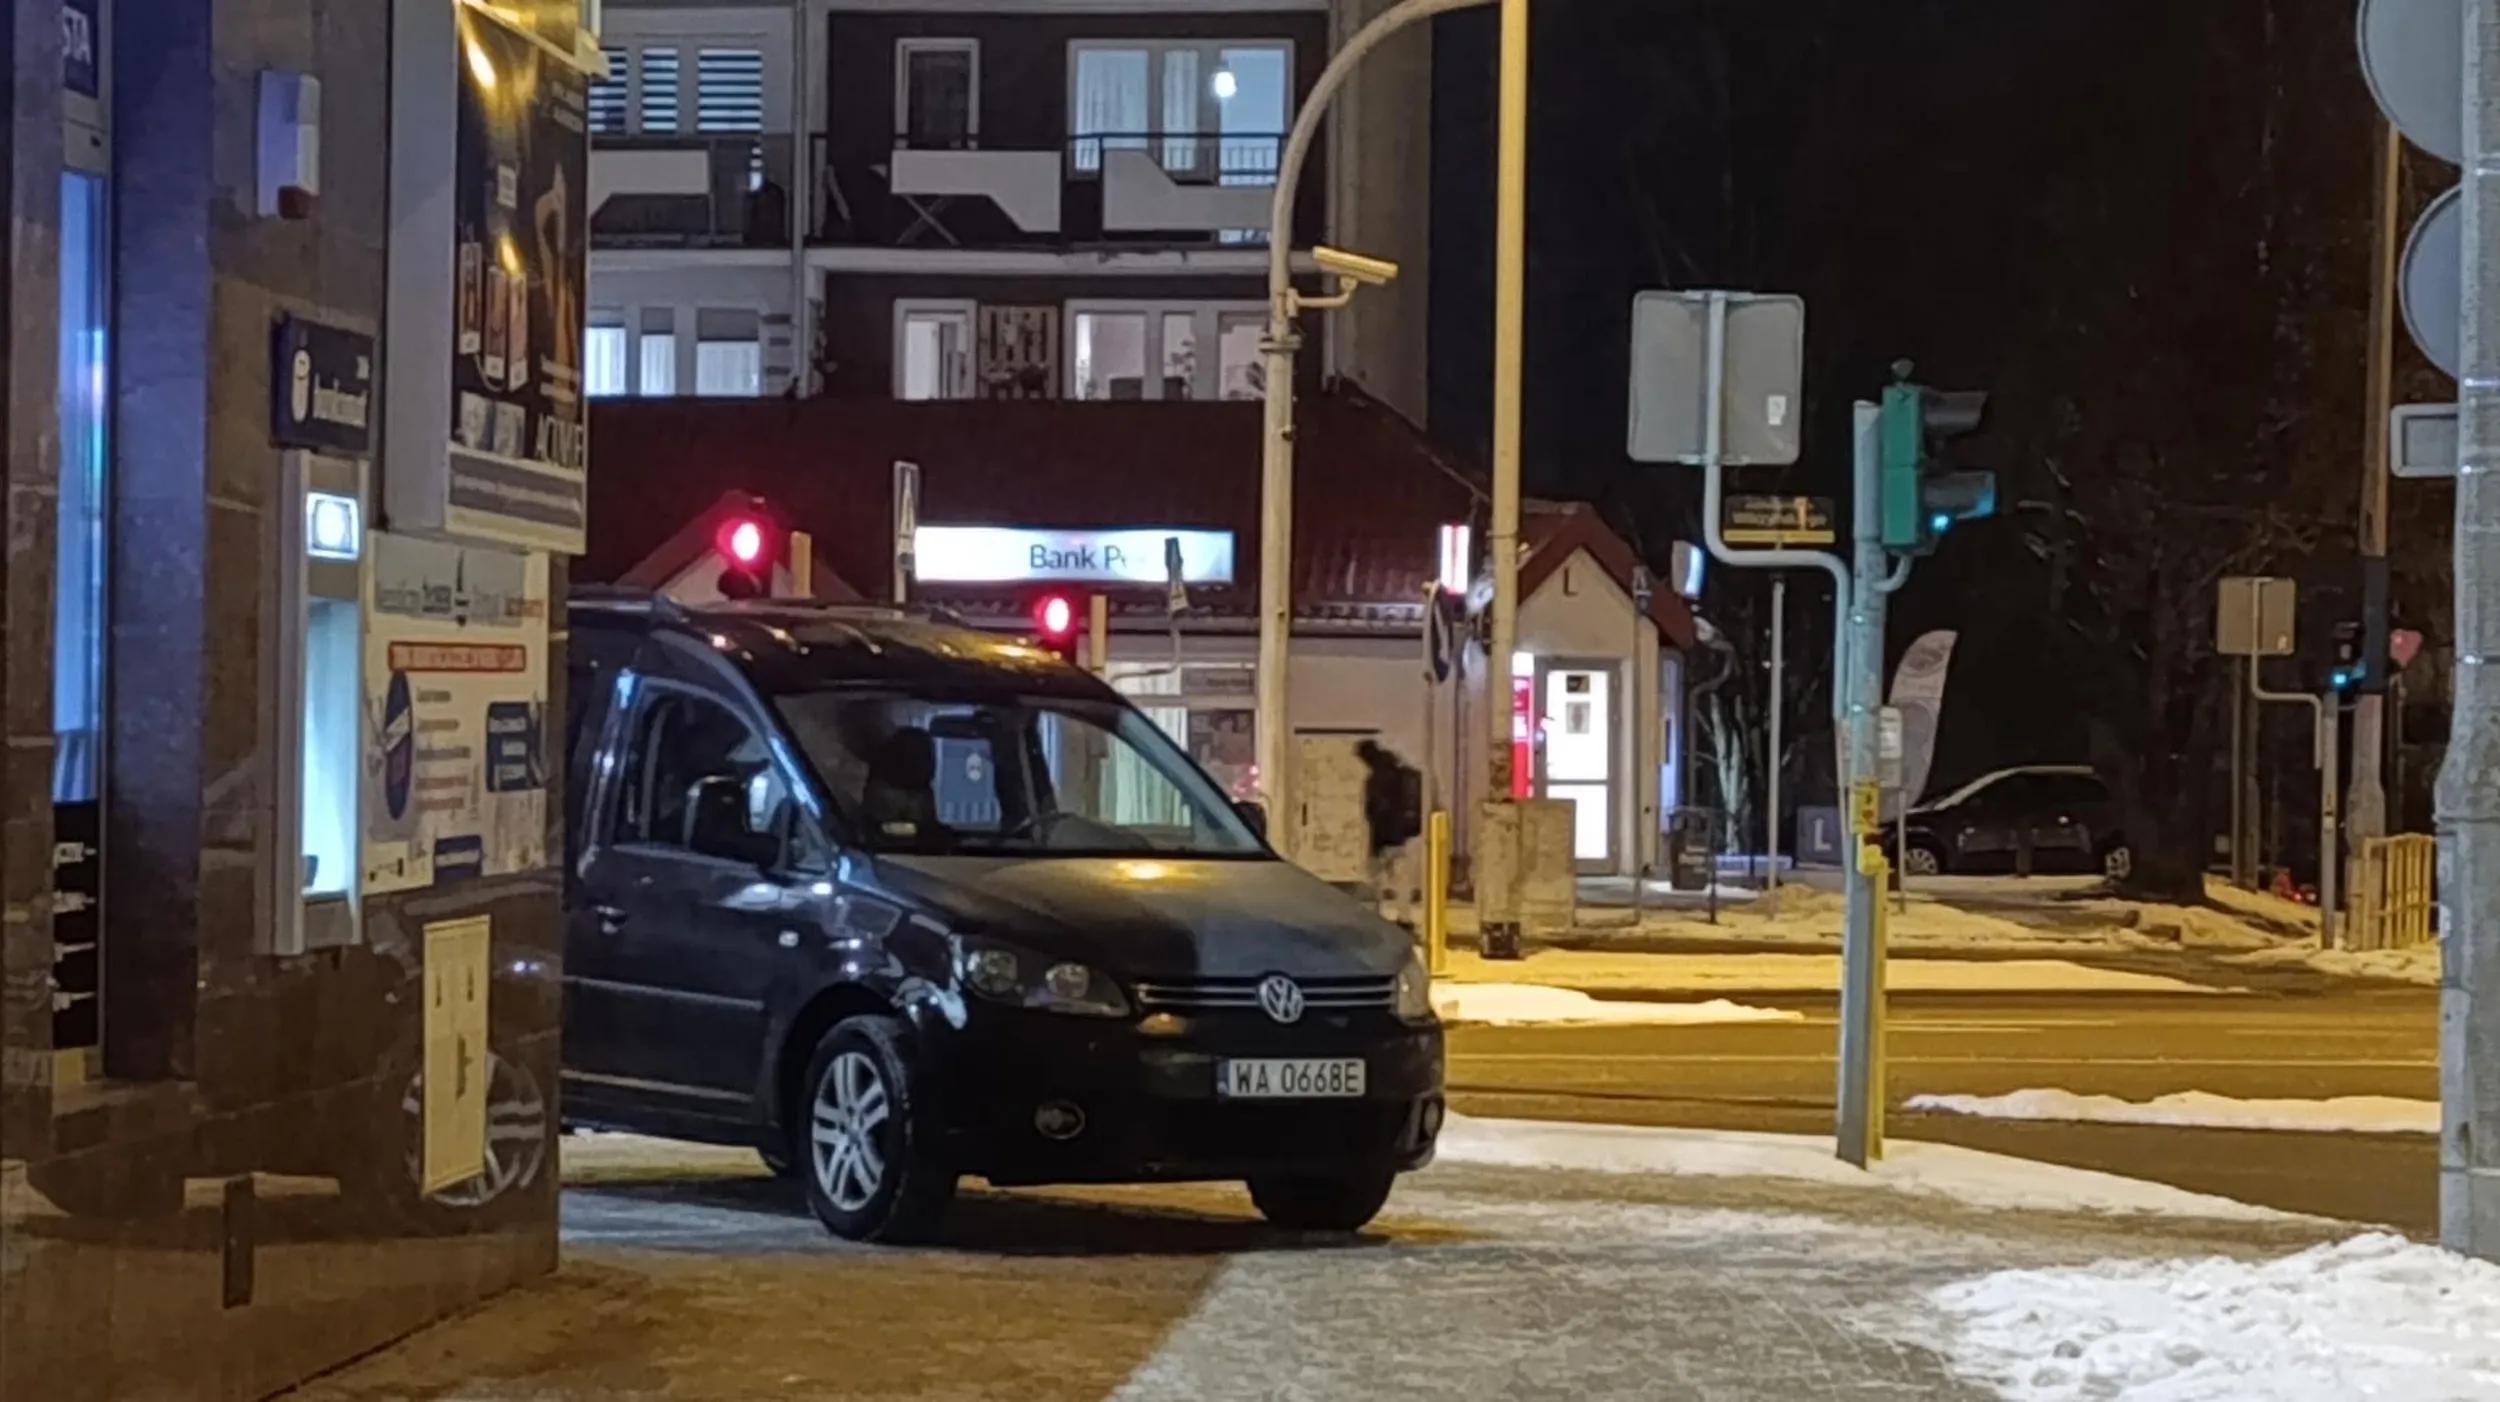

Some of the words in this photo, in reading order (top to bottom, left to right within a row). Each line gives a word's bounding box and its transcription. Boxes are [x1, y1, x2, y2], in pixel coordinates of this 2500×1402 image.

[1030, 545, 1097, 569] Bank
[1563, 568, 1578, 596] L
[1813, 818, 1832, 851] L
[1235, 1063, 1270, 1093] WA
[1281, 1062, 1358, 1093] 0668E
